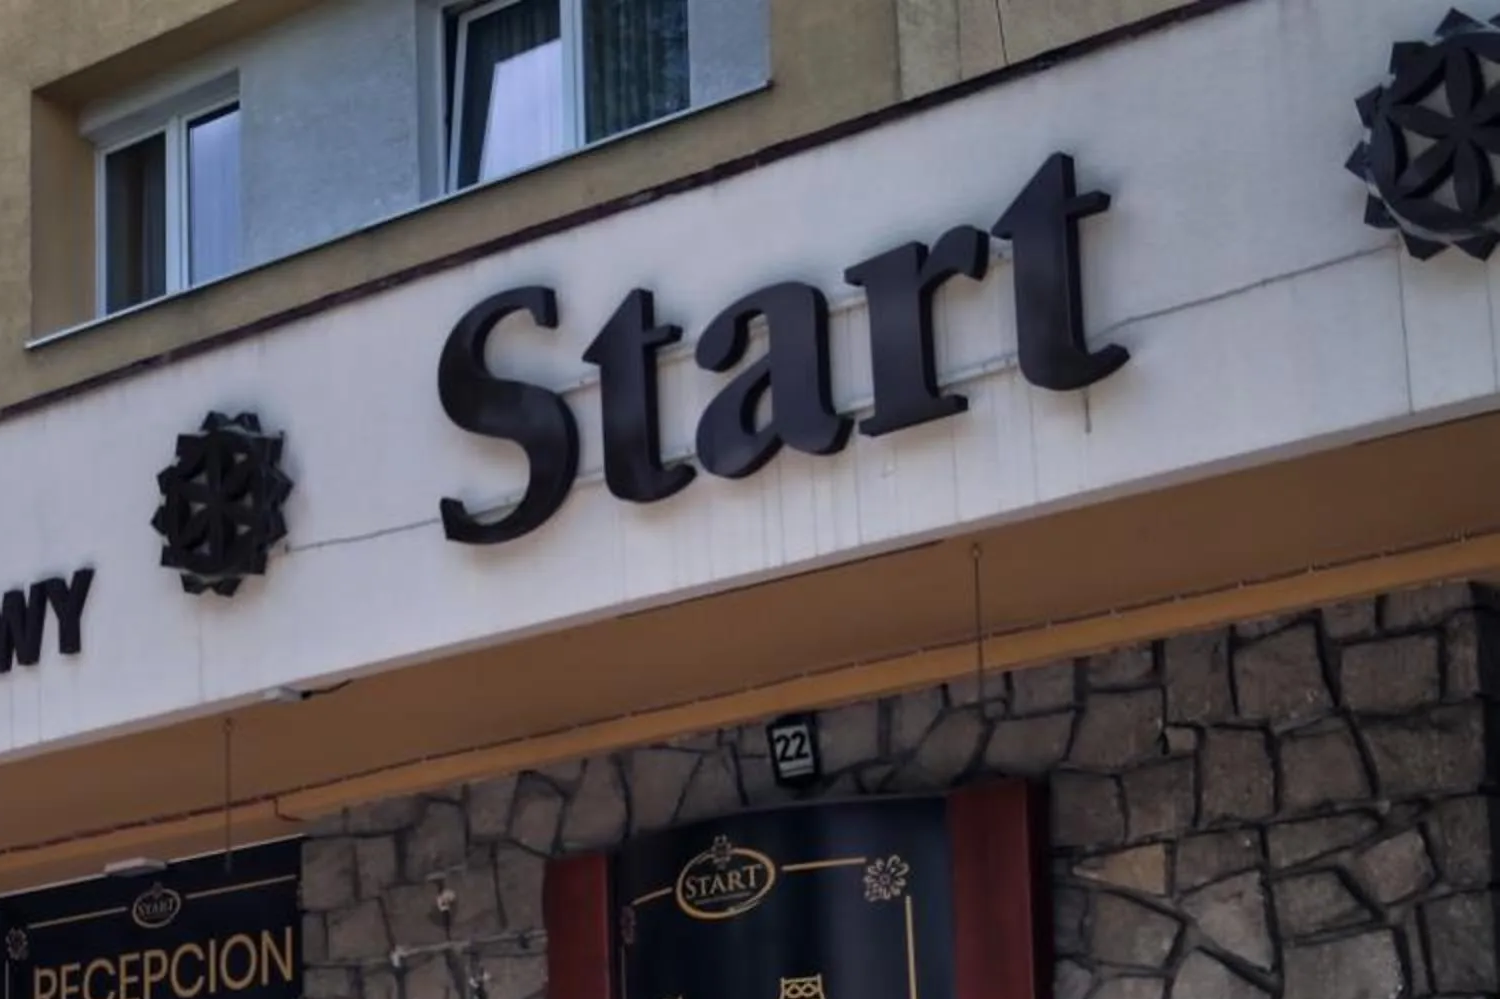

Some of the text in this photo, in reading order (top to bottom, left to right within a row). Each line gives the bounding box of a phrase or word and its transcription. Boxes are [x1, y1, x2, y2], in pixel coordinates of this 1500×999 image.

[437, 152, 1130, 546] Start
[775, 730, 810, 762] 22
[685, 863, 763, 899] START
